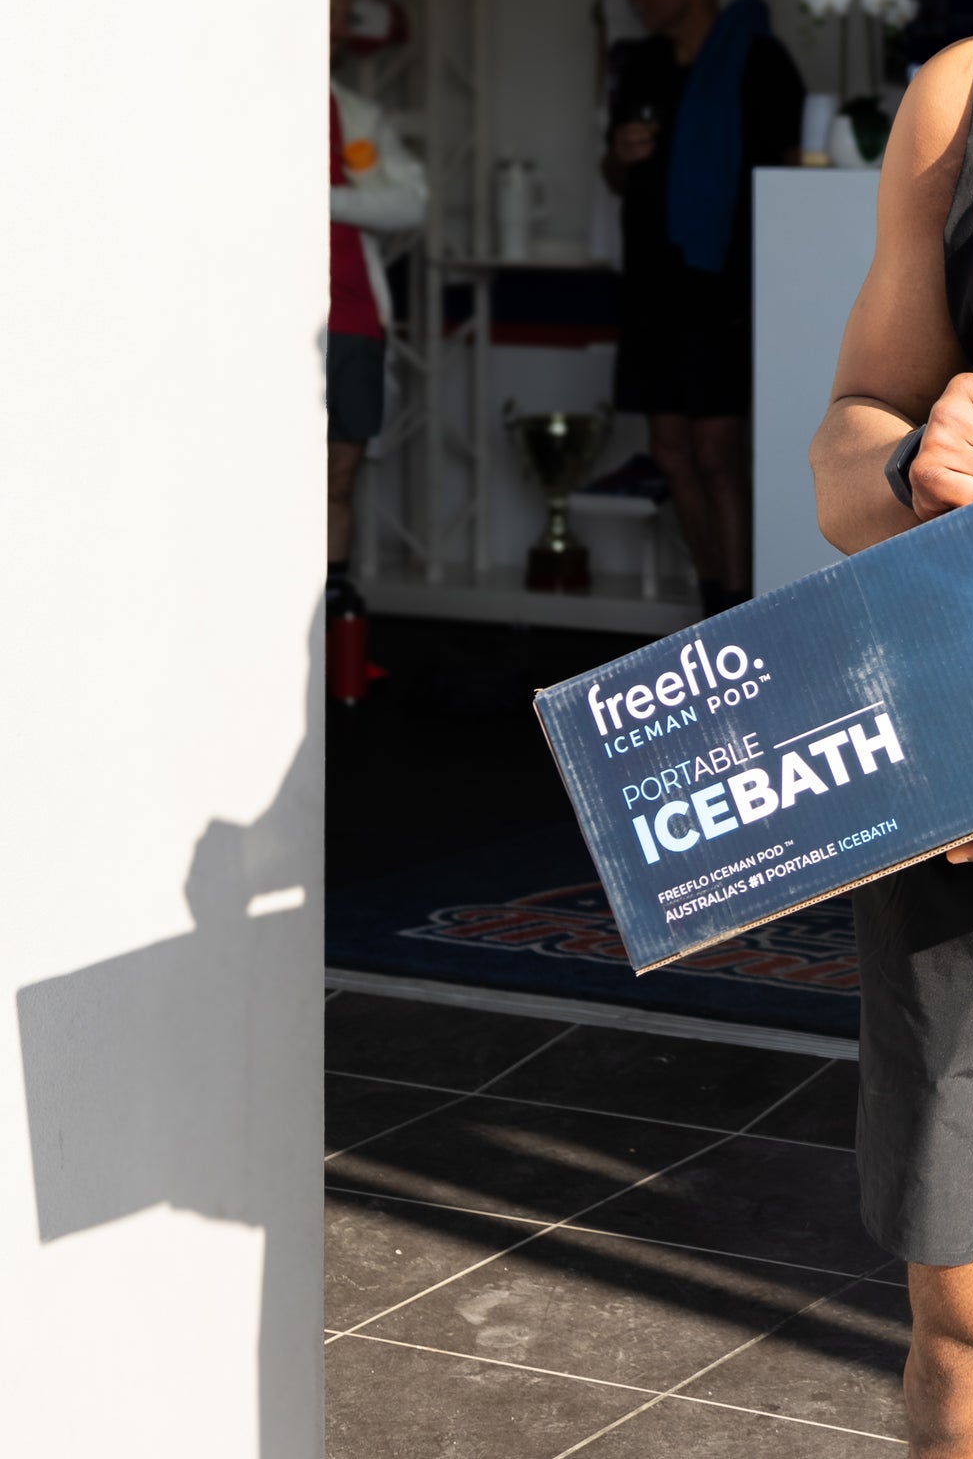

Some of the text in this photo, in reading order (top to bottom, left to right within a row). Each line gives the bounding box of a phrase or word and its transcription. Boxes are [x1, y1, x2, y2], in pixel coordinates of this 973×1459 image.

[588, 639, 764, 736] freeflo.
[604, 705, 698, 759] ICEMAN
[622, 732, 764, 810] PORTABLE
[632, 712, 905, 865] ICEBATH
[657, 874, 709, 904] FREEFLO
[709, 855, 756, 882] ICEMAN
[665, 818, 899, 923] AUSTRALIA'S #1 PORTABLE ICEBATH
